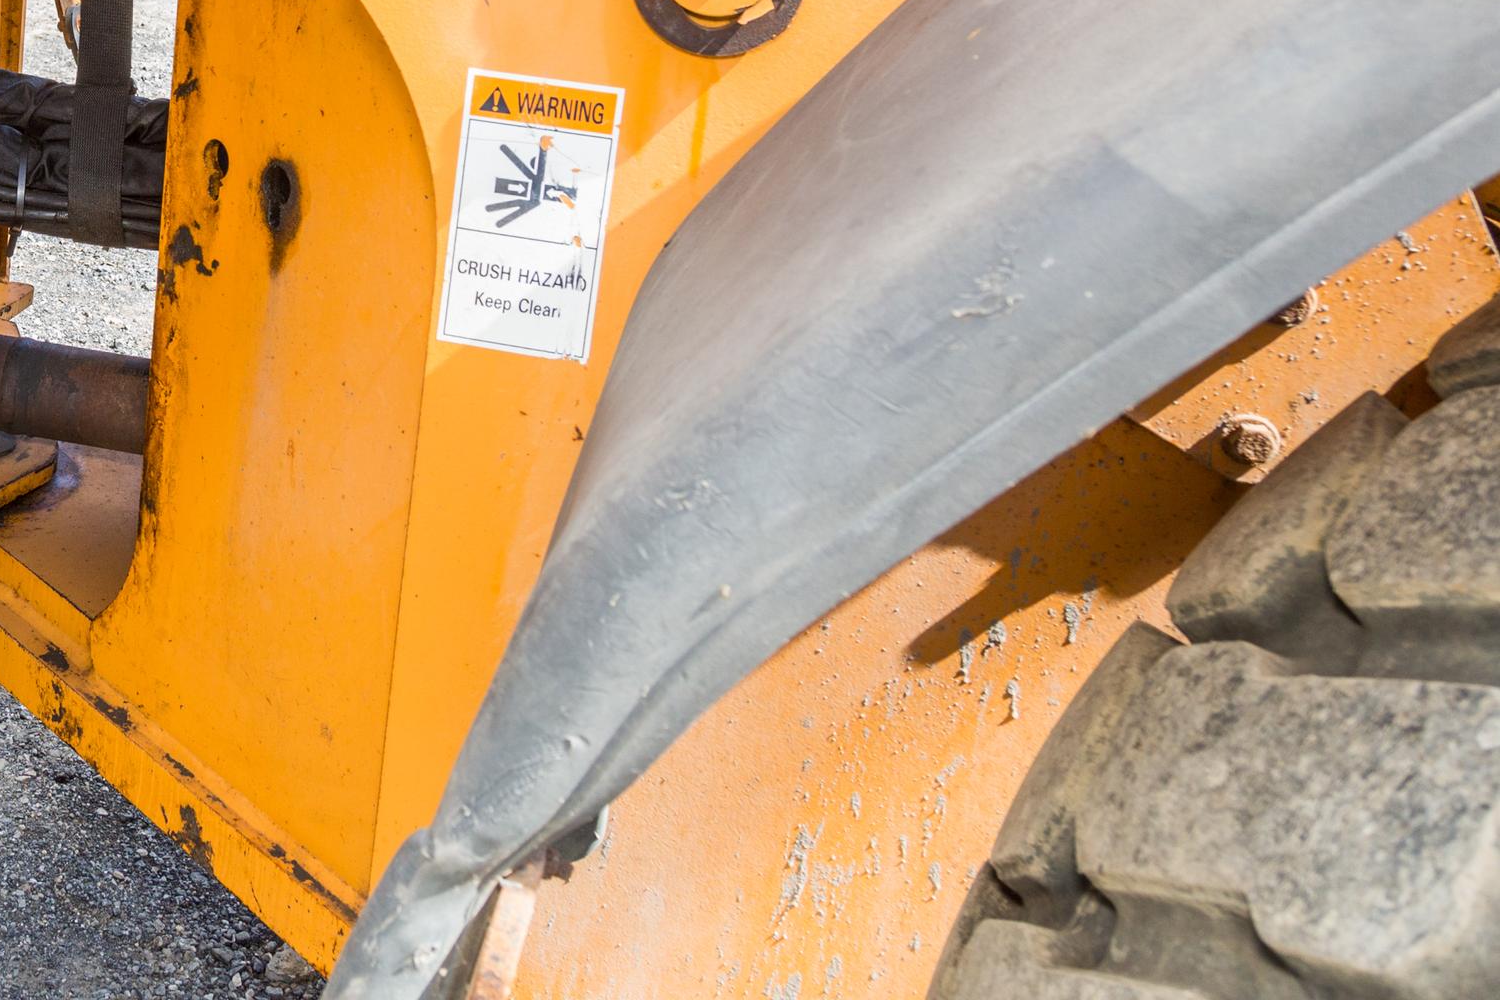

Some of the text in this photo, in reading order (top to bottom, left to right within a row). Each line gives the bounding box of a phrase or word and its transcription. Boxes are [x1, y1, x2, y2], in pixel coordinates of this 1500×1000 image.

[517, 92, 605, 125] WARNING
[457, 258, 587, 292] CRUSH HAZARD
[474, 291, 512, 313] Keep
